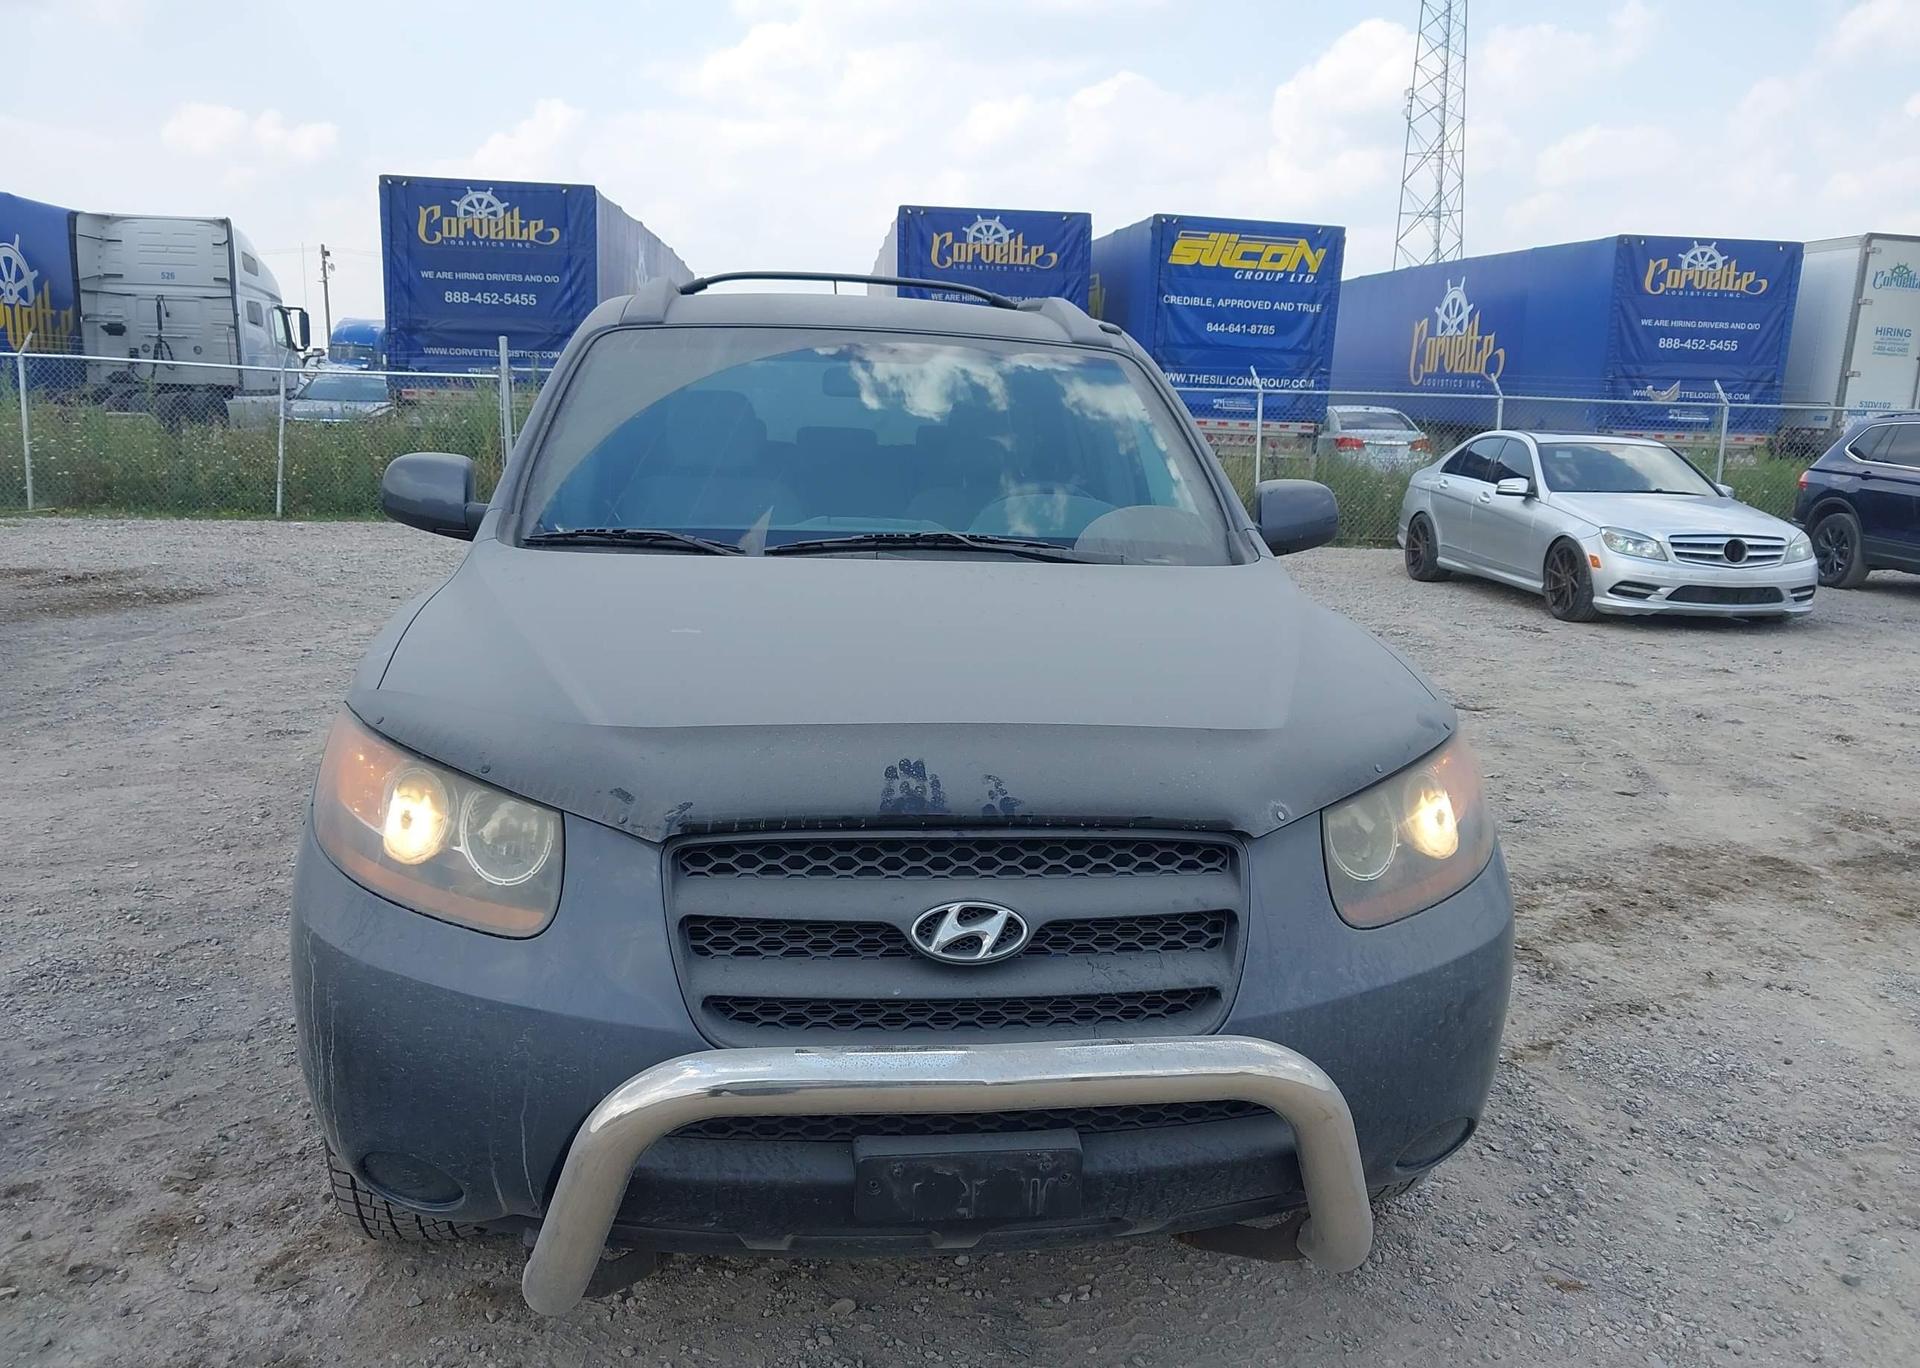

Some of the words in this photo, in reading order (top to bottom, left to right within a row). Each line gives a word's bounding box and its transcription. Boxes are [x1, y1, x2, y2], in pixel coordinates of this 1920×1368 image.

[418, 205, 560, 245] Corvette
[443, 239, 505, 248] LOGISTICS
[931, 232, 1058, 269] Corvette
[953, 264, 1008, 272] LOGISTICS
[420, 270, 434, 279] WE
[436, 271, 454, 280] ARE
[455, 272, 485, 281] HIRING
[486, 273, 523, 282] DRIVERS
[524, 274, 542, 283] AND
[544, 275, 560, 284] O/O
[1234, 270, 1284, 282] GROUP
[1289, 272, 1318, 284] LTD.
[1645, 258, 1768, 295] Corvette
[444, 291, 537, 306] 888-452-5455
[931, 292, 944, 301] WE
[945, 293, 960, 302] ARE
[1665, 289, 1719, 298] LOGISTICS
[1163, 294, 1216, 308] CREDIBLE,
[1217, 297, 1272, 311] APPROVED
[1273, 301, 1295, 312] AND
[1297, 302, 1323, 313] TRUE
[1206, 322, 1275, 335] 844-641-8785
[1641, 318, 1653, 326] WE
[1654, 319, 1670, 327] ARE
[1671, 320, 1697, 328] HIRING
[1698, 321, 1729, 329] DRIVERS
[1730, 322, 1746, 330] AND
[1875, 326, 1912, 338] HIRING
[1410, 310, 1505, 386] Corvette
[1658, 337, 1739, 352] 888-452-5455
[1423, 378, 1462, 388] LOGISTICS
